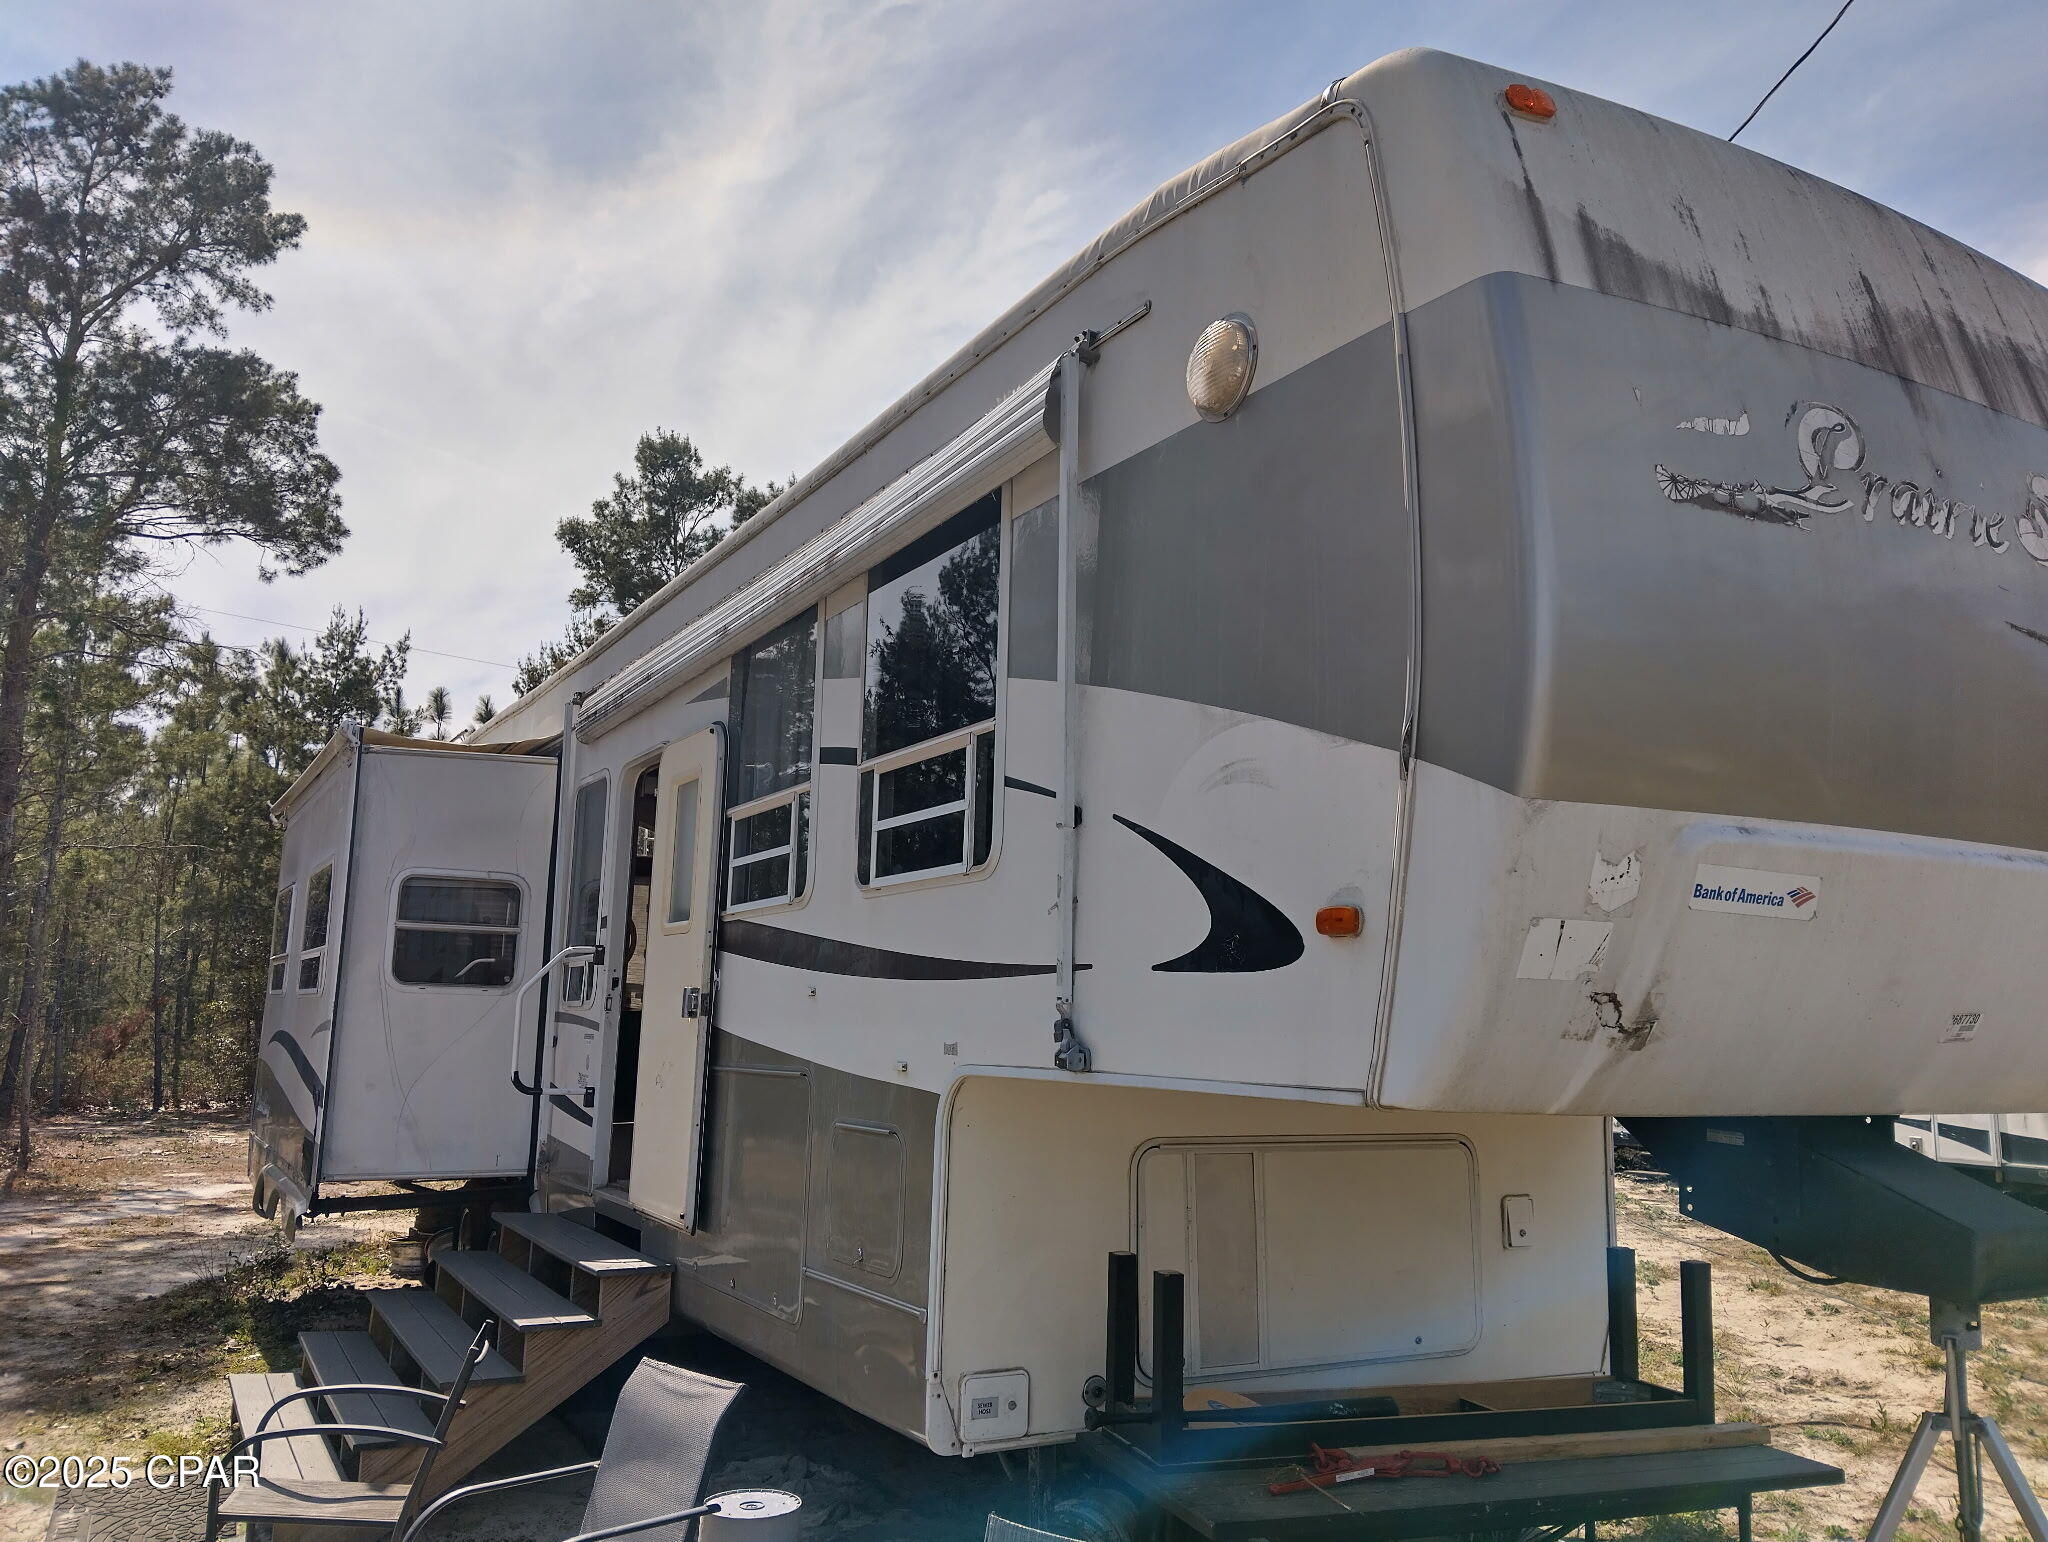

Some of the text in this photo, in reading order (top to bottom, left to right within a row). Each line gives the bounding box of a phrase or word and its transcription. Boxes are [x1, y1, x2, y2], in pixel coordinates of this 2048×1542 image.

[1693, 883, 1785, 907] Bank of America
